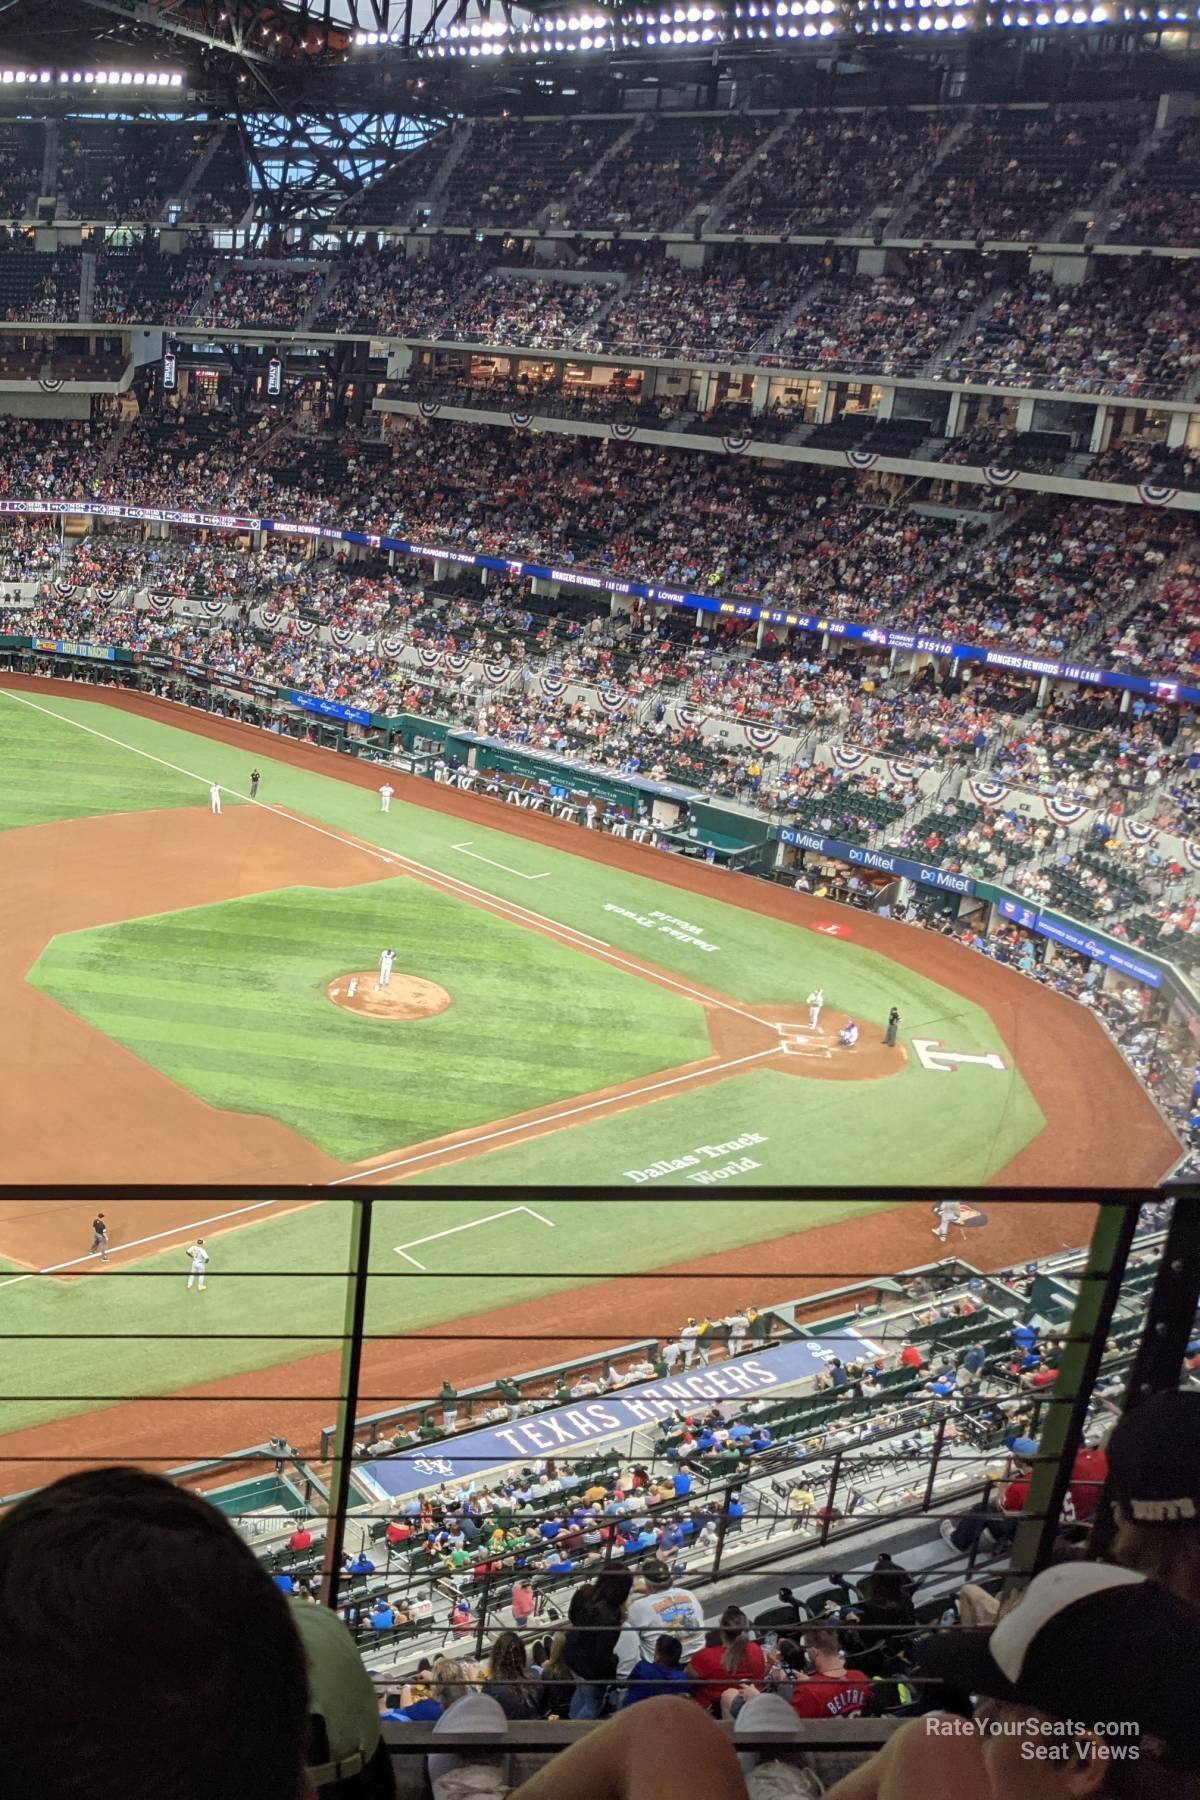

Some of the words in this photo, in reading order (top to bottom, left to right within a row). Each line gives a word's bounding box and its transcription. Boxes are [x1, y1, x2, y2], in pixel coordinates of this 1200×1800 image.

[410, 545, 422, 554] TEXT
[423, 547, 449, 559] RANGERS
[657, 591, 684, 602] LOWRIE
[736, 606, 752, 615] .255
[772, 612, 782, 621] 13
[799, 618, 809, 626] 62
[888, 633, 915, 643] CURRENT
[917, 640, 952, 654] $15110
[62, 640, 78, 655] HOW
[88, 645, 110, 660] NACHO
[986, 652, 1023, 669] RANGERS
[1022, 659, 1059, 675] REWARDS
[795, 832, 824, 851] Mitel
[863, 852, 895, 871] Mitel
[937, 872, 970, 891] Mitel
[602, 903, 657, 928] Truck
[648, 910, 704, 935] World
[658, 925, 721, 952] Dallas
[911, 1039, 1006, 1072] T
[623, 1154, 700, 1184] Dallas
[694, 1132, 769, 1159] Truck
[686, 1156, 763, 1185] World
[495, 1405, 621, 1455] TEXAS
[620, 1361, 778, 1420] RANGERS
